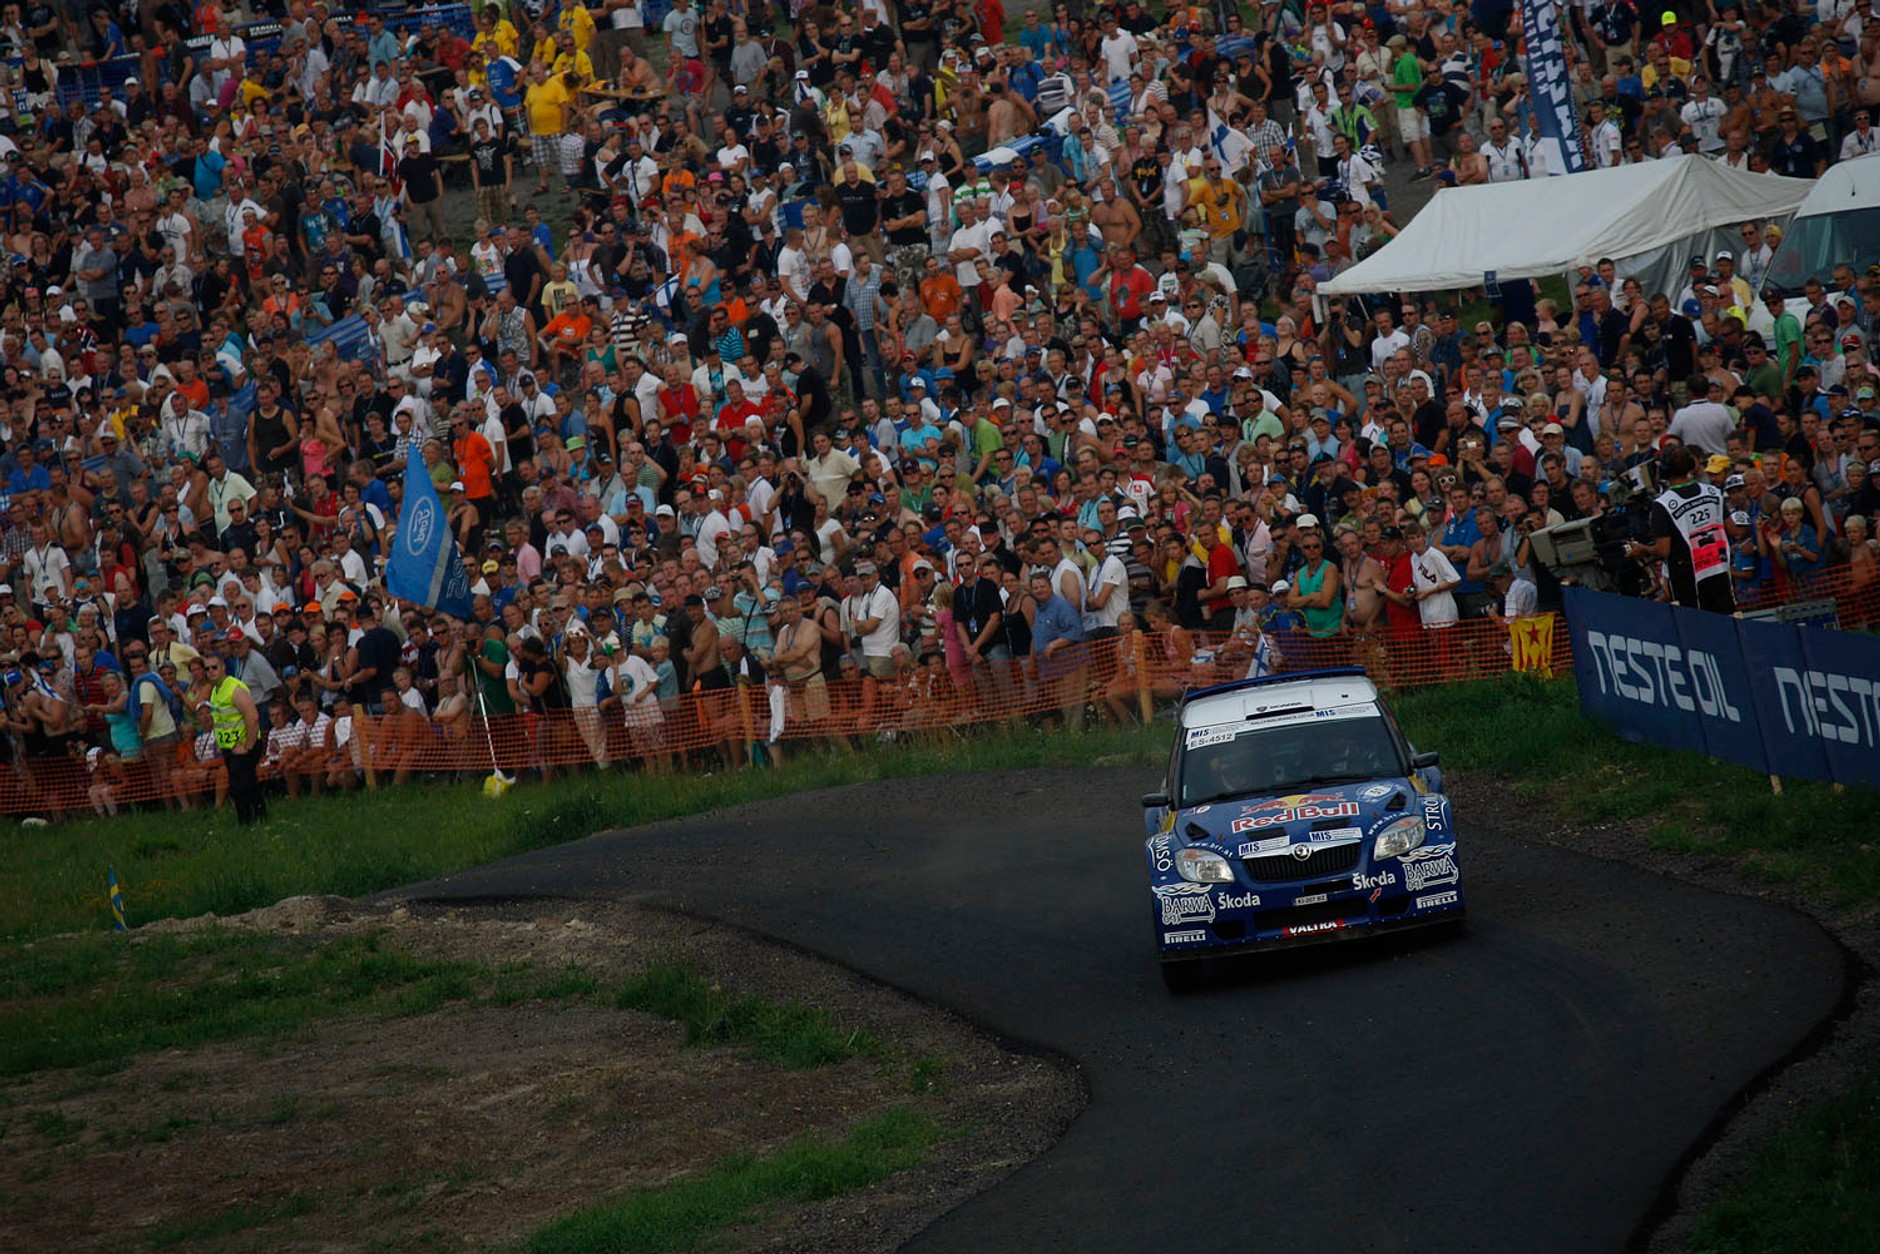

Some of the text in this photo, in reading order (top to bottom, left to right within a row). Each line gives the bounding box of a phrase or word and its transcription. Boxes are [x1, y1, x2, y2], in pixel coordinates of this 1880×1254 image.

[1690, 508, 1711, 524] 225
[1418, 563, 1437, 584] FILA
[1587, 630, 1741, 722] NESTE OIL
[1316, 709, 1336, 719] MIS
[218, 730, 240, 743] 223
[1190, 728, 1210, 740] MIS
[1231, 808, 1295, 833] Red
[1297, 802, 1359, 820] Bull
[1310, 831, 1332, 842] MIS
[1240, 842, 1260, 854] MIS
[1404, 855, 1456, 881] BARWA
[1352, 870, 1397, 891] Škoda
[1162, 894, 1213, 915] BARWA
[1218, 892, 1261, 910] Škoda
[1416, 890, 1458, 909] PIRELLI
[1164, 930, 1206, 944] PIRELLI
